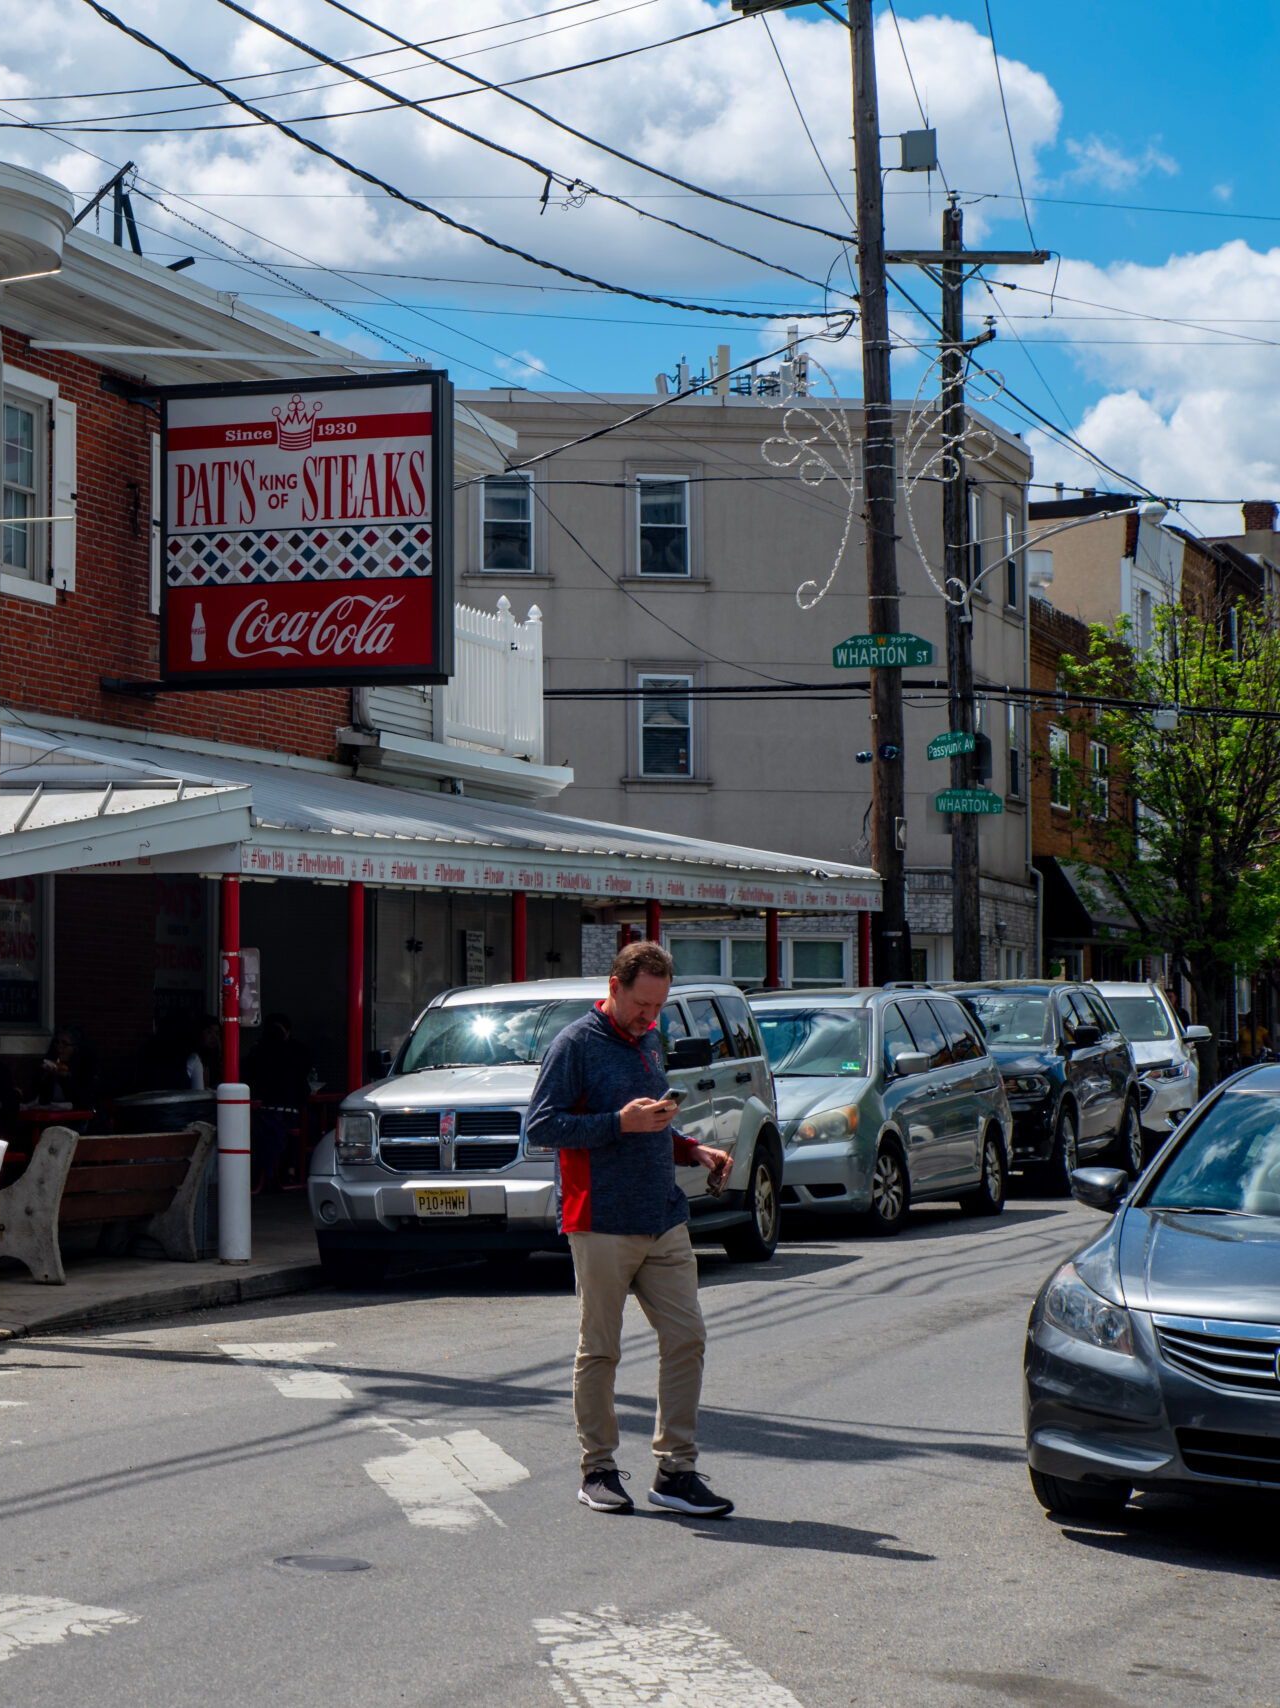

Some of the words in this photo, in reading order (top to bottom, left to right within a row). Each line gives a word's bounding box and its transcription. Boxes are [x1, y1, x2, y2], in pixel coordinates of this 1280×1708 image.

[225, 428, 272, 442] Since
[317, 422, 357, 436] 1930
[259, 474, 298, 491] KING
[301, 450, 426, 522] STEAKS
[175, 458, 256, 527] PAT'S
[268, 493, 289, 510] OF
[227, 594, 406, 658] Coca-Cola
[876, 637, 886, 646] W
[837, 646, 907, 666] WHARTON
[916, 650, 929, 663] ST
[928, 740, 961, 758] Passyunk
[937, 797, 989, 812] WHARTON
[993, 803, 1001, 813] ST
